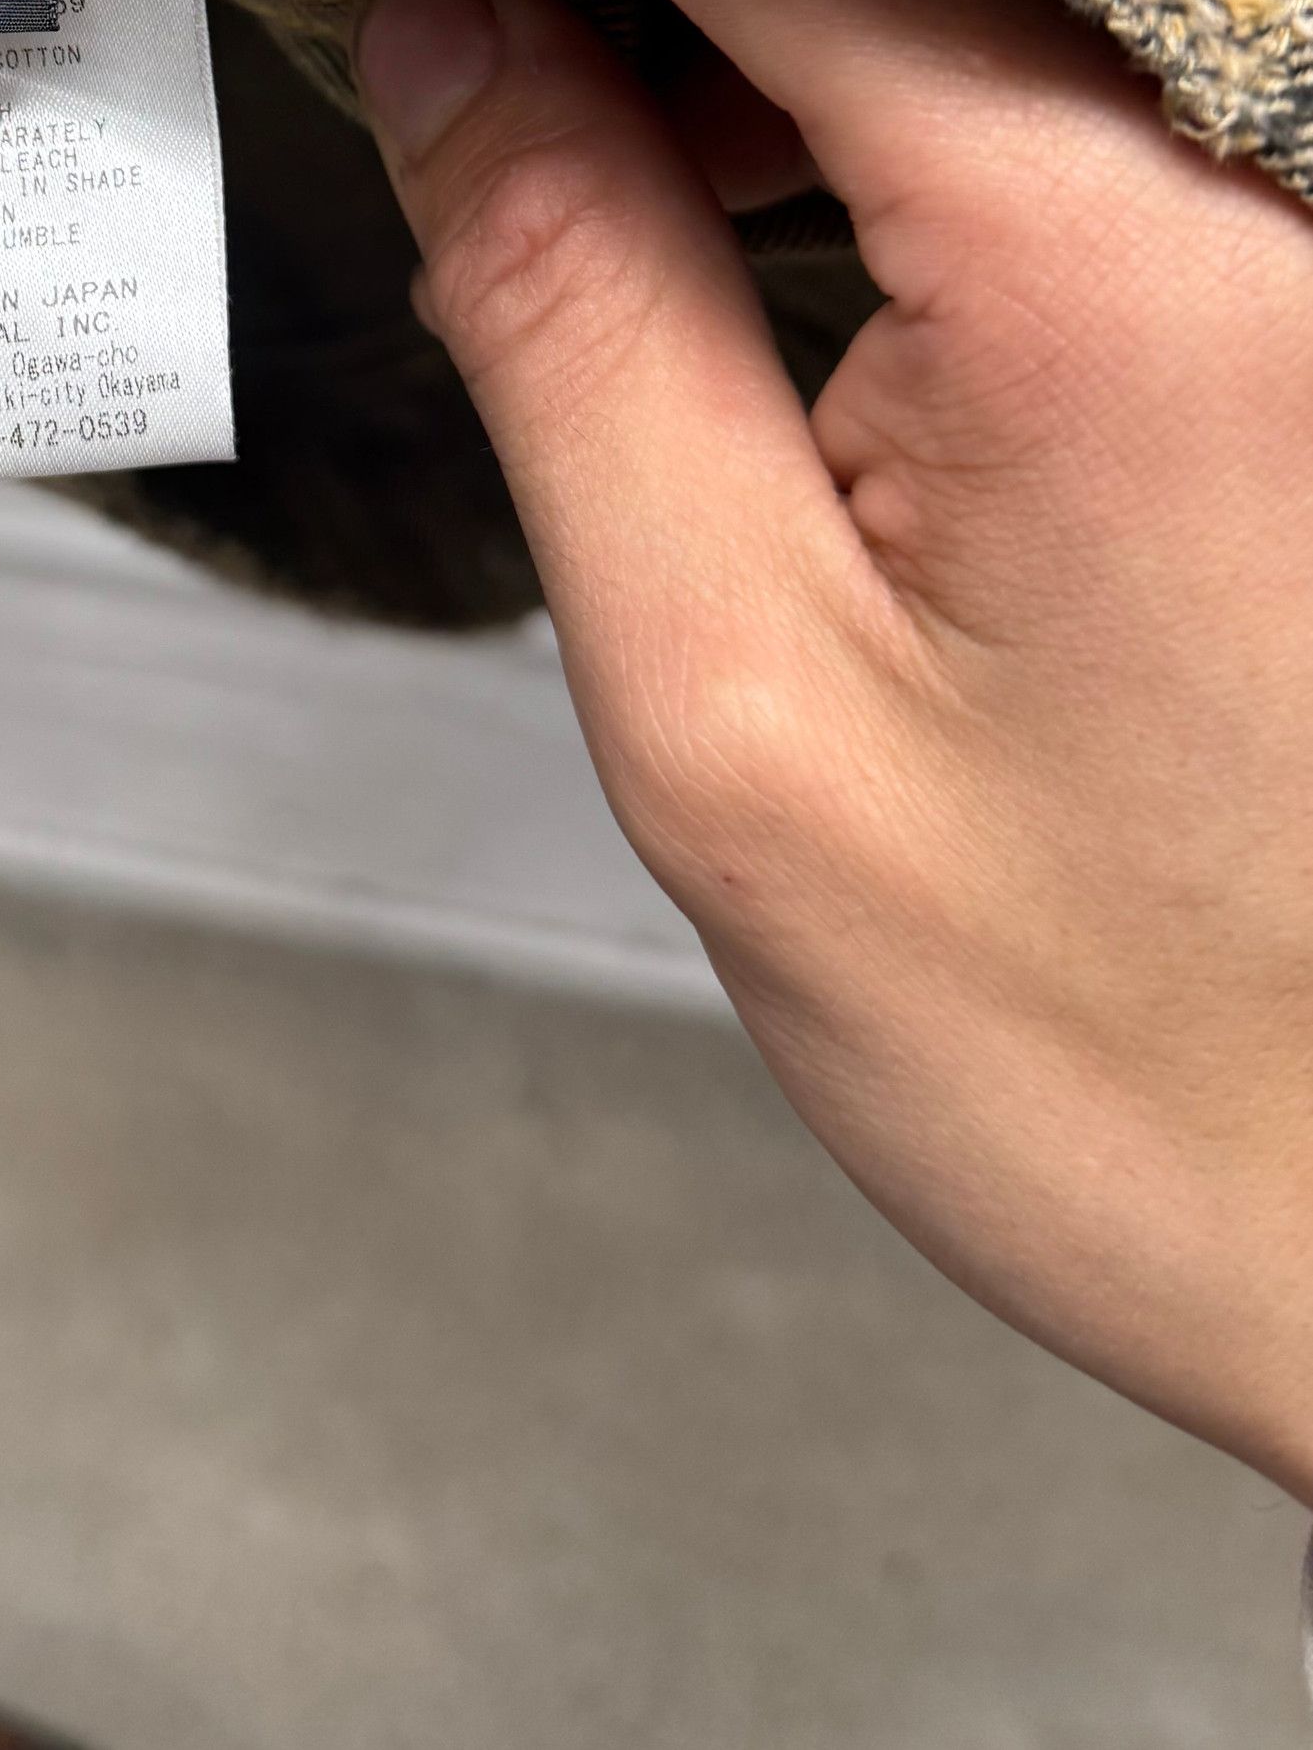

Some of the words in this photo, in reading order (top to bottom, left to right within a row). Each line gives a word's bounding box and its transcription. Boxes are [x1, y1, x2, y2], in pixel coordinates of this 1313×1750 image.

[20, 175, 47, 198] IN
[66, 165, 142, 193] SHADE
[42, 277, 138, 308] JAPAN
[12, 341, 138, 380] Ogawa-cho
[98, 370, 181, 400] Okayama
